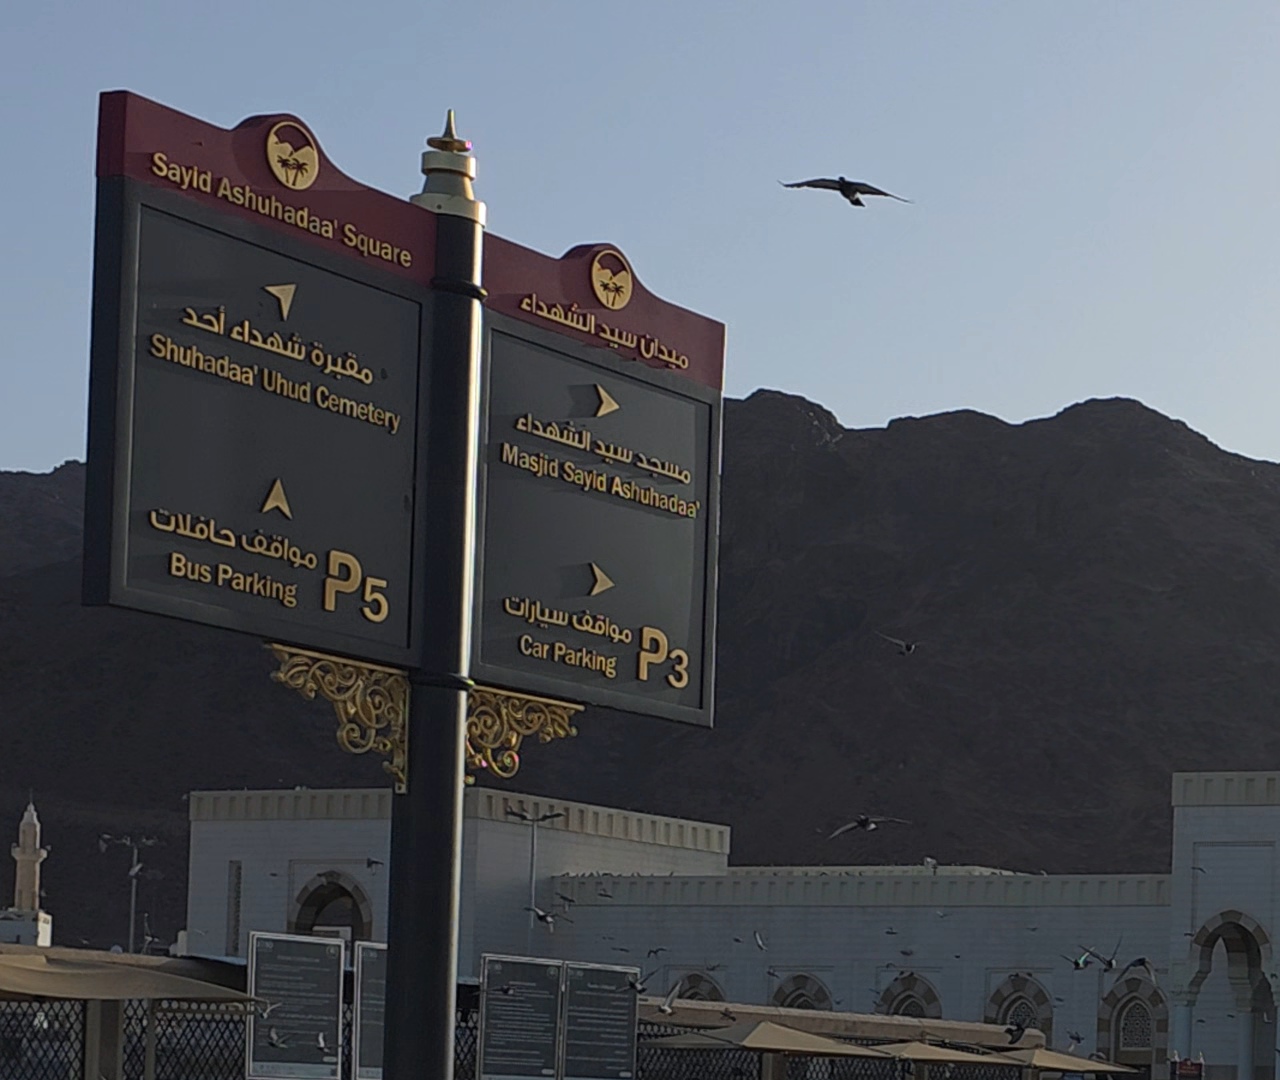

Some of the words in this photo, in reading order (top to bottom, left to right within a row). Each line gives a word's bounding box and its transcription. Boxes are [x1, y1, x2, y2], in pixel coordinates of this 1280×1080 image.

[152, 152, 212, 193] Sayid
[217, 177, 338, 239] Ashuhadaa'
[343, 223, 412, 267] Square
[182, 305, 226, 335] أحد
[520, 293, 596, 334] الشهداء
[230, 320, 306, 360] شهداء
[600, 322, 638, 348] سيد
[640, 334, 690, 369] ميدان
[310, 341, 373, 385] مقبرة
[151, 333, 258, 386] Shuhadaa'
[263, 367, 311, 404] Uhud
[316, 385, 400, 434] Cemetery
[516, 413, 591, 451] الشهداء
[594, 440, 633, 464] سيد
[502, 442, 559, 477] Masjid
[563, 461, 607, 491] Sayid
[611, 476, 700, 519] Ashuhadaa'
[636, 453, 691, 485] مسجد
[151, 508, 236, 547] حافلات
[241, 528, 317, 569] مواقف
[171, 552, 212, 583] Bus
[217, 563, 298, 608] Parking
[324, 550, 390, 623] P5
[505, 597, 569, 628] سيارات
[572, 610, 633, 644] مواقف
[520, 634, 550, 660] Car
[553, 642, 618, 679] Parking
[637, 626, 689, 689] P3
